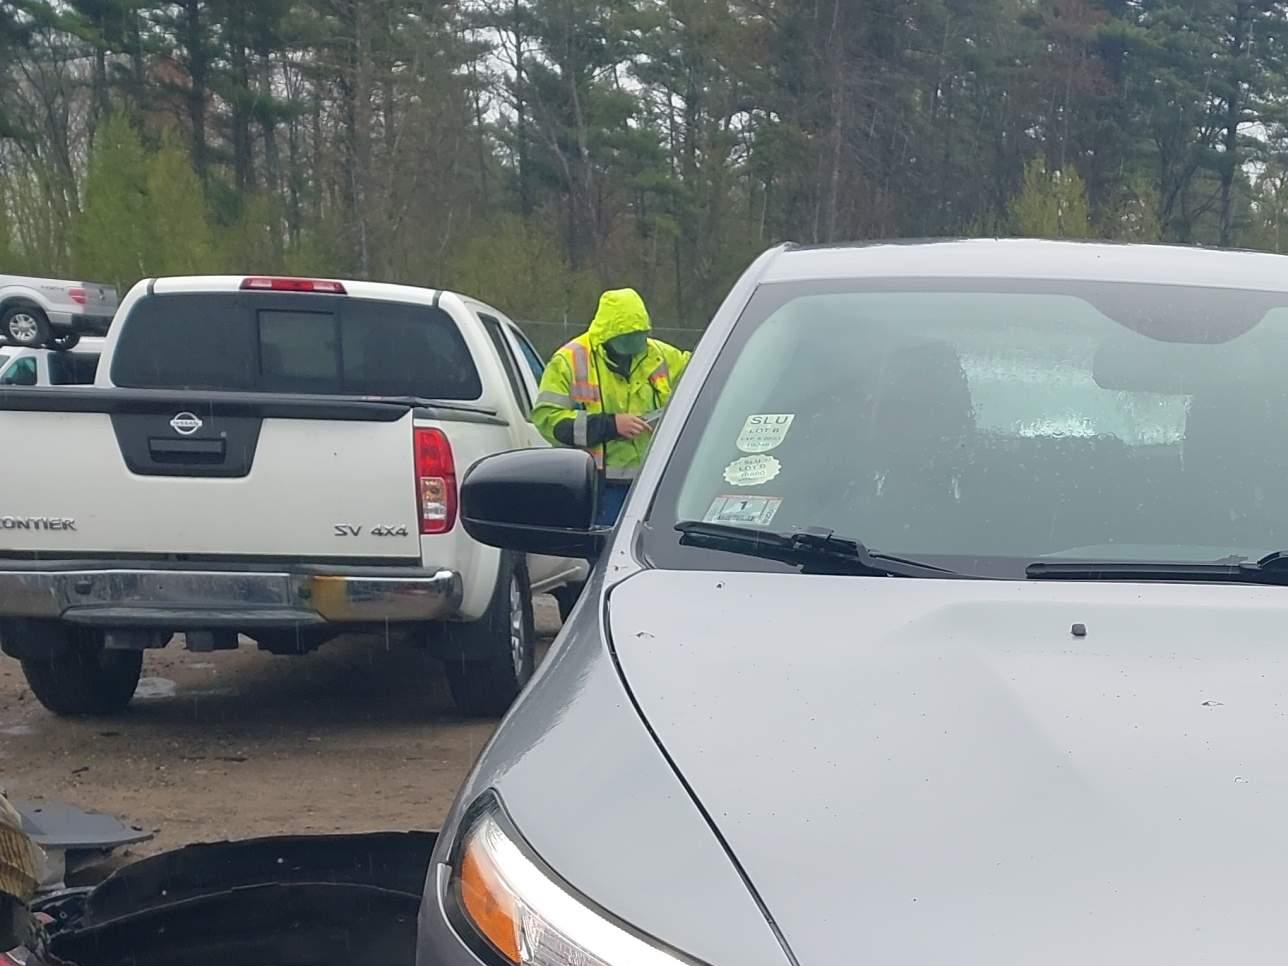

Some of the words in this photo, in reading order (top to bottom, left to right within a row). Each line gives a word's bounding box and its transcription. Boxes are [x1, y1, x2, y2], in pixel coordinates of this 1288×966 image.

[750, 416, 789, 425] SLU
[0, 516, 77, 531] ONTIER
[334, 523, 362, 536] SV
